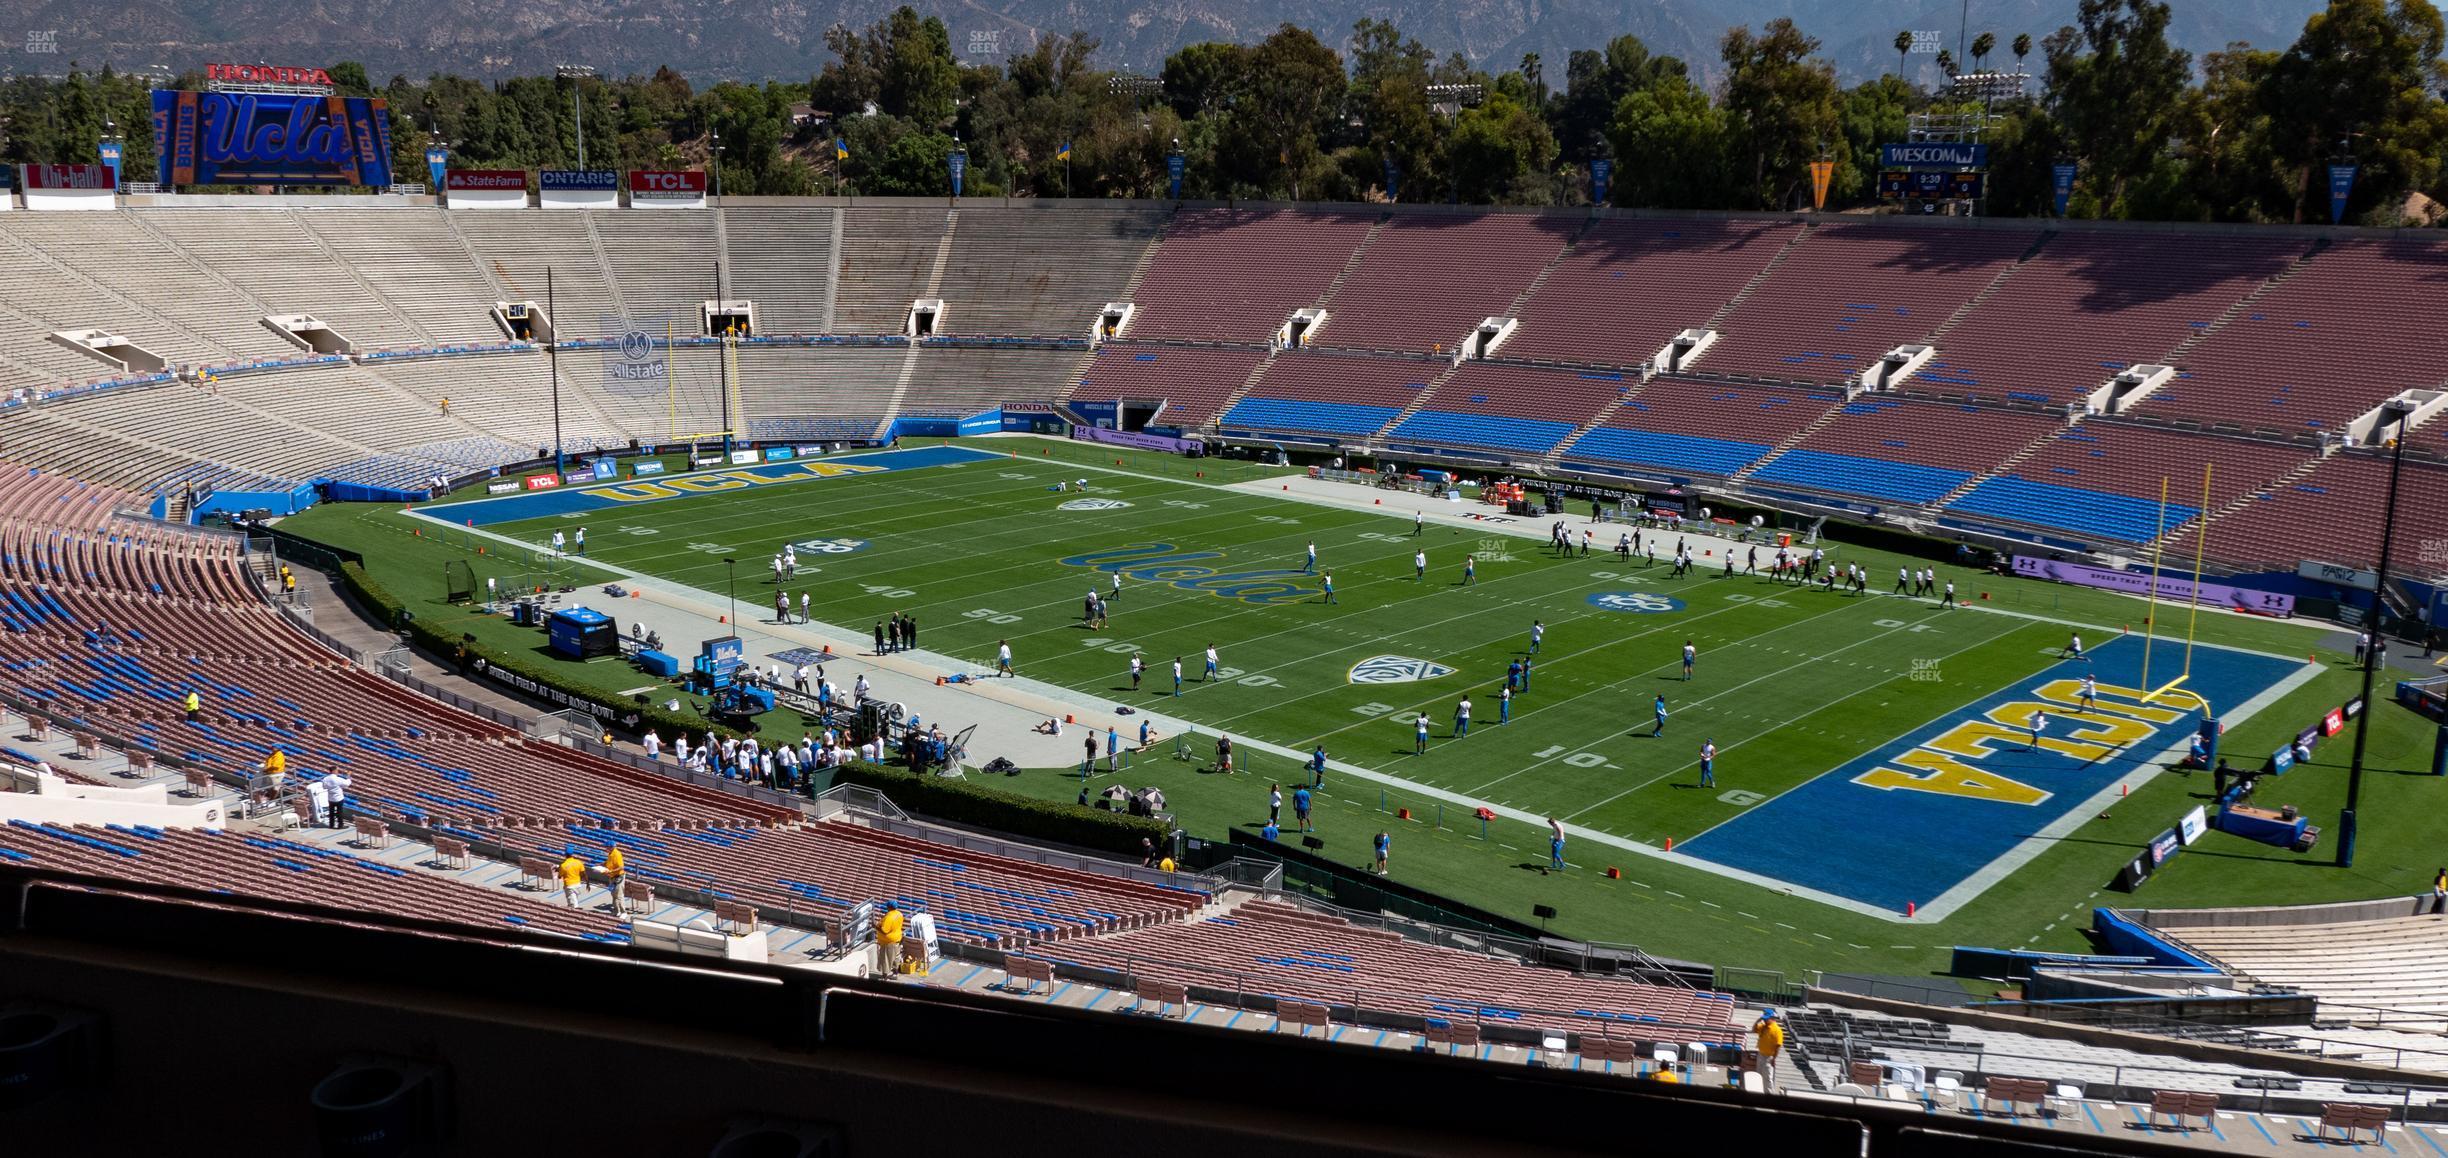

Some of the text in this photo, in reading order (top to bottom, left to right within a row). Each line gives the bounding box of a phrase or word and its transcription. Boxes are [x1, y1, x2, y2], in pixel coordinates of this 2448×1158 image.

[205, 63, 335, 85] HONDA
[176, 105, 194, 168] BRUINS
[355, 118, 376, 163] UCLA
[1892, 148, 1955, 162] WESCOM
[644, 174, 693, 188] TCL
[1920, 175, 1940, 183] 9:30
[509, 305, 526, 317] 40
[1003, 403, 1051, 412] HONDA
[490, 481, 520, 492] NISSAN
[530, 476, 555, 488] TCL
[582, 462, 889, 501] UCLA
[1550, 481, 1572, 491] FIELD
[1574, 485, 1585, 493] AT
[1586, 486, 1602, 495] THE
[1603, 489, 1622, 498] ROSE
[1625, 492, 1645, 501] BOWL
[1056, 541, 1324, 605] Ucla
[1598, 594, 1673, 611] 100
[961, 608, 1023, 624] 50
[515, 676, 537, 693] FIELD
[538, 684, 549, 697] AT
[550, 689, 568, 705] THE
[569, 697, 590, 711] ROSE
[591, 703, 617, 721] BOWL
[1849, 679, 2209, 806] UCLA
[1532, 745, 1608, 768] 10
